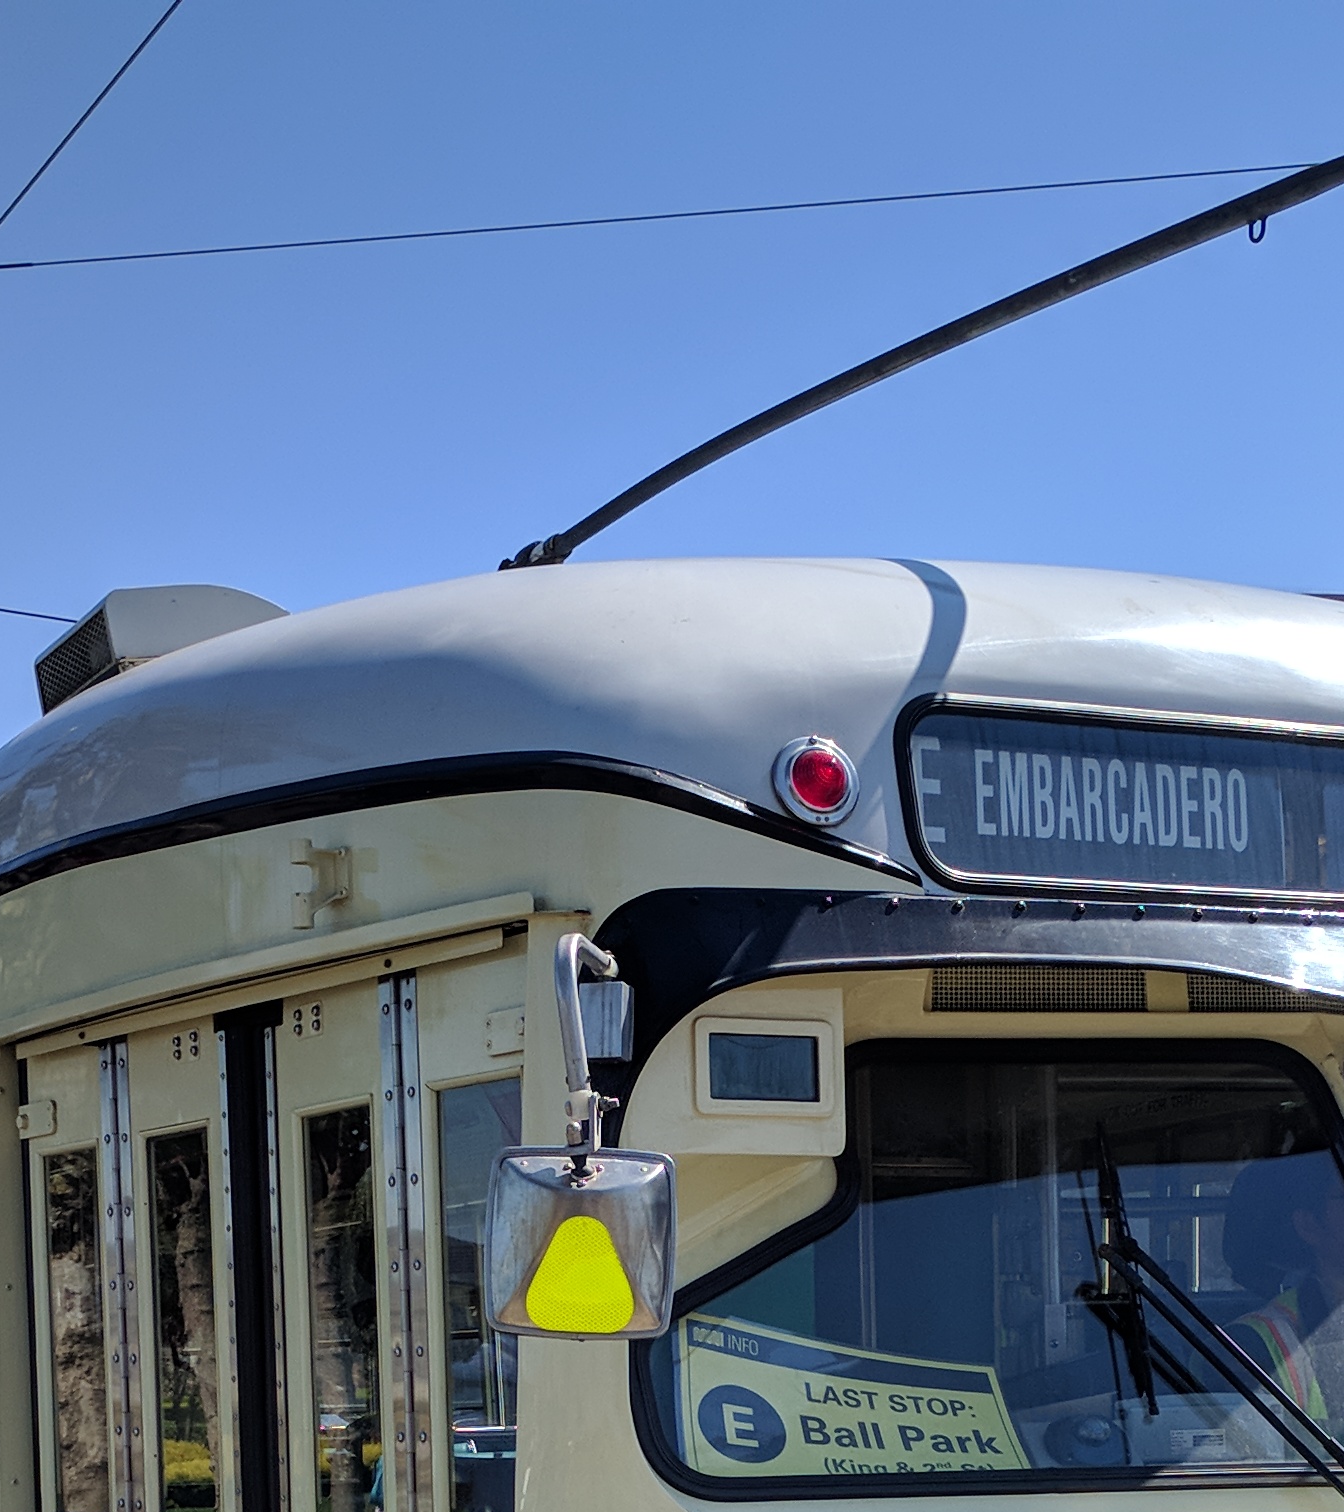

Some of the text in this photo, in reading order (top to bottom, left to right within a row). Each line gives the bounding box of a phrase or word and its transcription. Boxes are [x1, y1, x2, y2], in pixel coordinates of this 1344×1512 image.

[909, 735, 946, 843] E
[973, 749, 1249, 853] EMBARCADERO
[727, 1333, 759, 1356] INFO
[805, 1382, 976, 1418] LAST STOP:
[722, 1402, 760, 1448] E
[800, 1415, 1004, 1455] Ball Park
